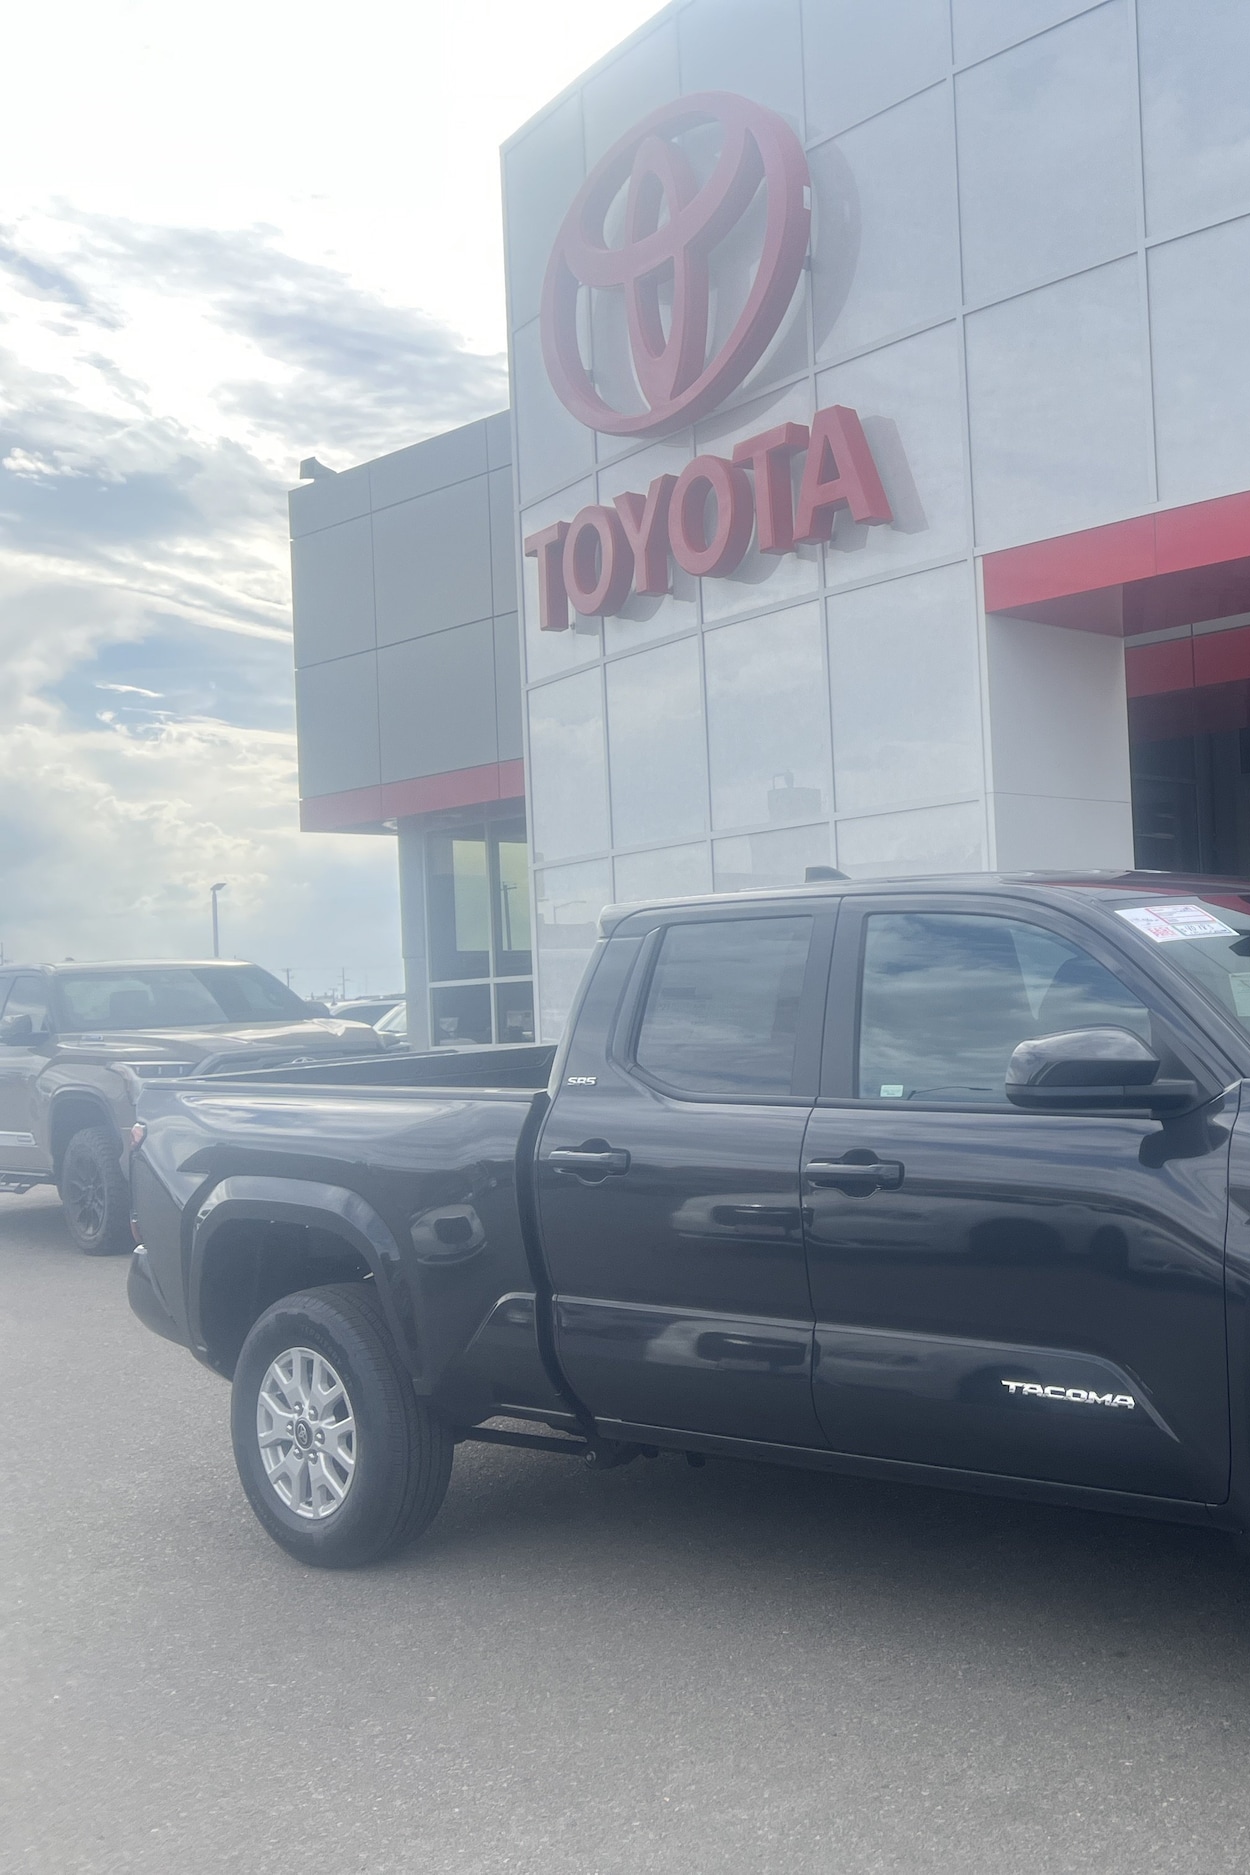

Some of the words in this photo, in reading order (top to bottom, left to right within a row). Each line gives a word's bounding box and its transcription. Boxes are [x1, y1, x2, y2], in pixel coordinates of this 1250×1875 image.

[524, 404, 894, 633] TOYOTA
[567, 1076, 597, 1086] SR5
[1000, 1379, 1136, 1410] TACOMA
